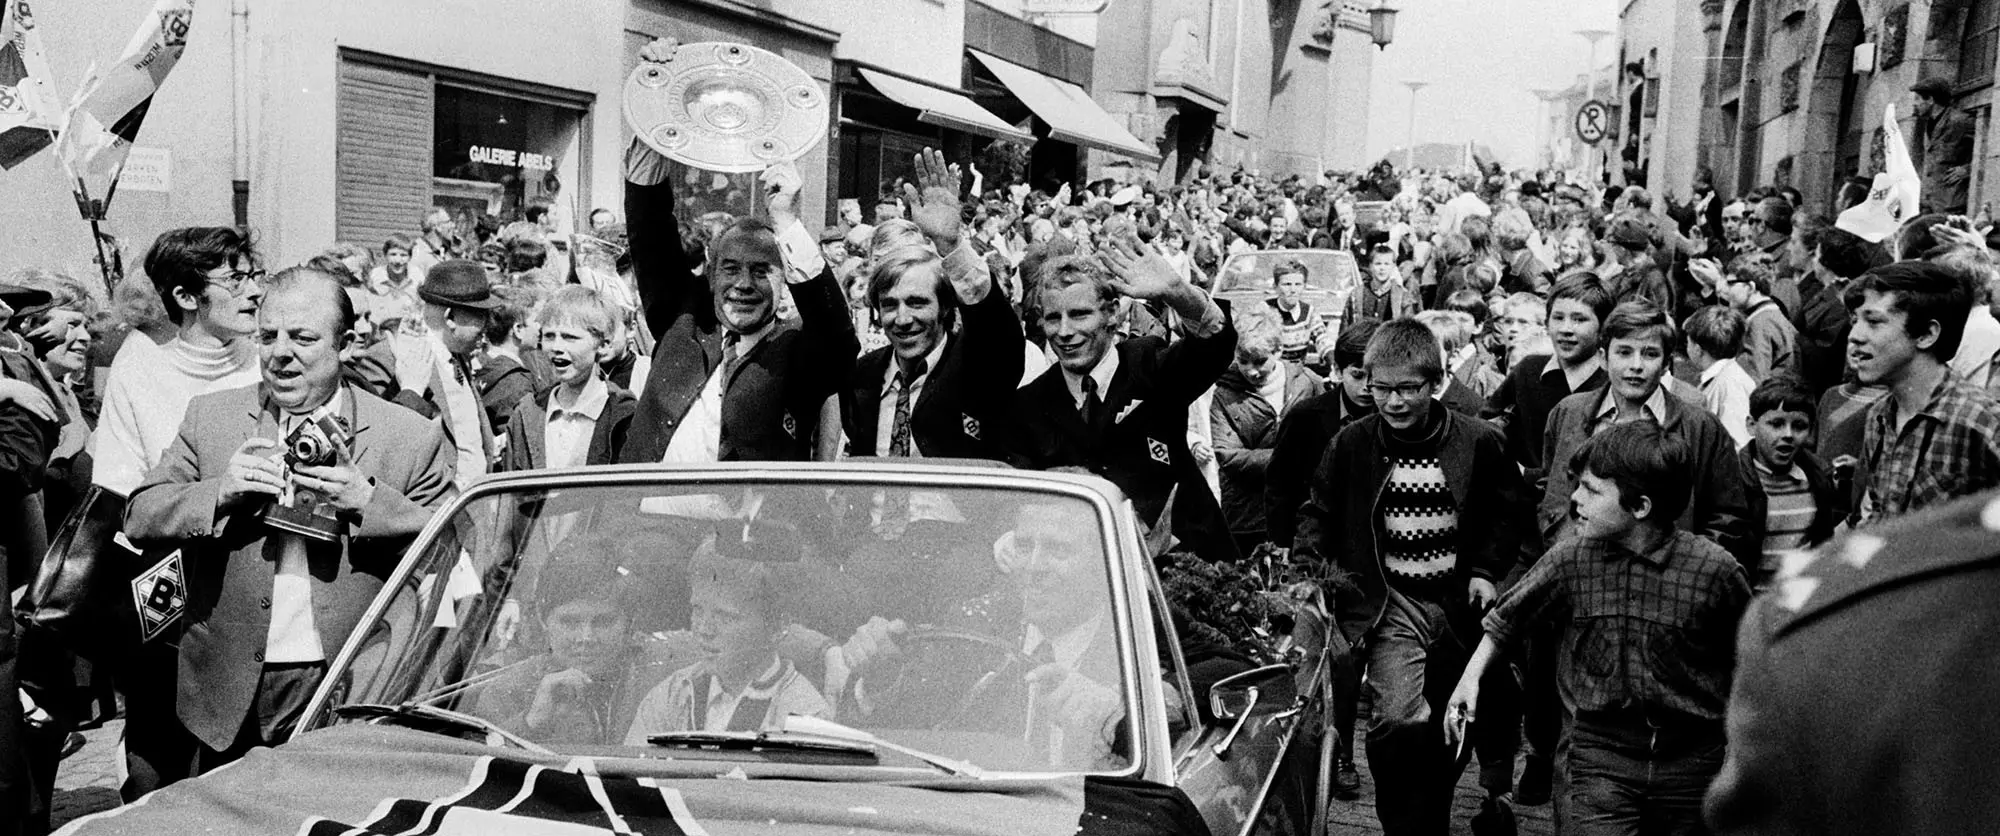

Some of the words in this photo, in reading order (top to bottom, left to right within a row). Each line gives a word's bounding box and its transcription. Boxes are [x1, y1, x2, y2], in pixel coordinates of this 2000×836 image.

[469, 145, 516, 167] GALERIE
[518, 152, 553, 171] ABELS
[1151, 443, 1166, 459] B
[145, 576, 177, 615] B
